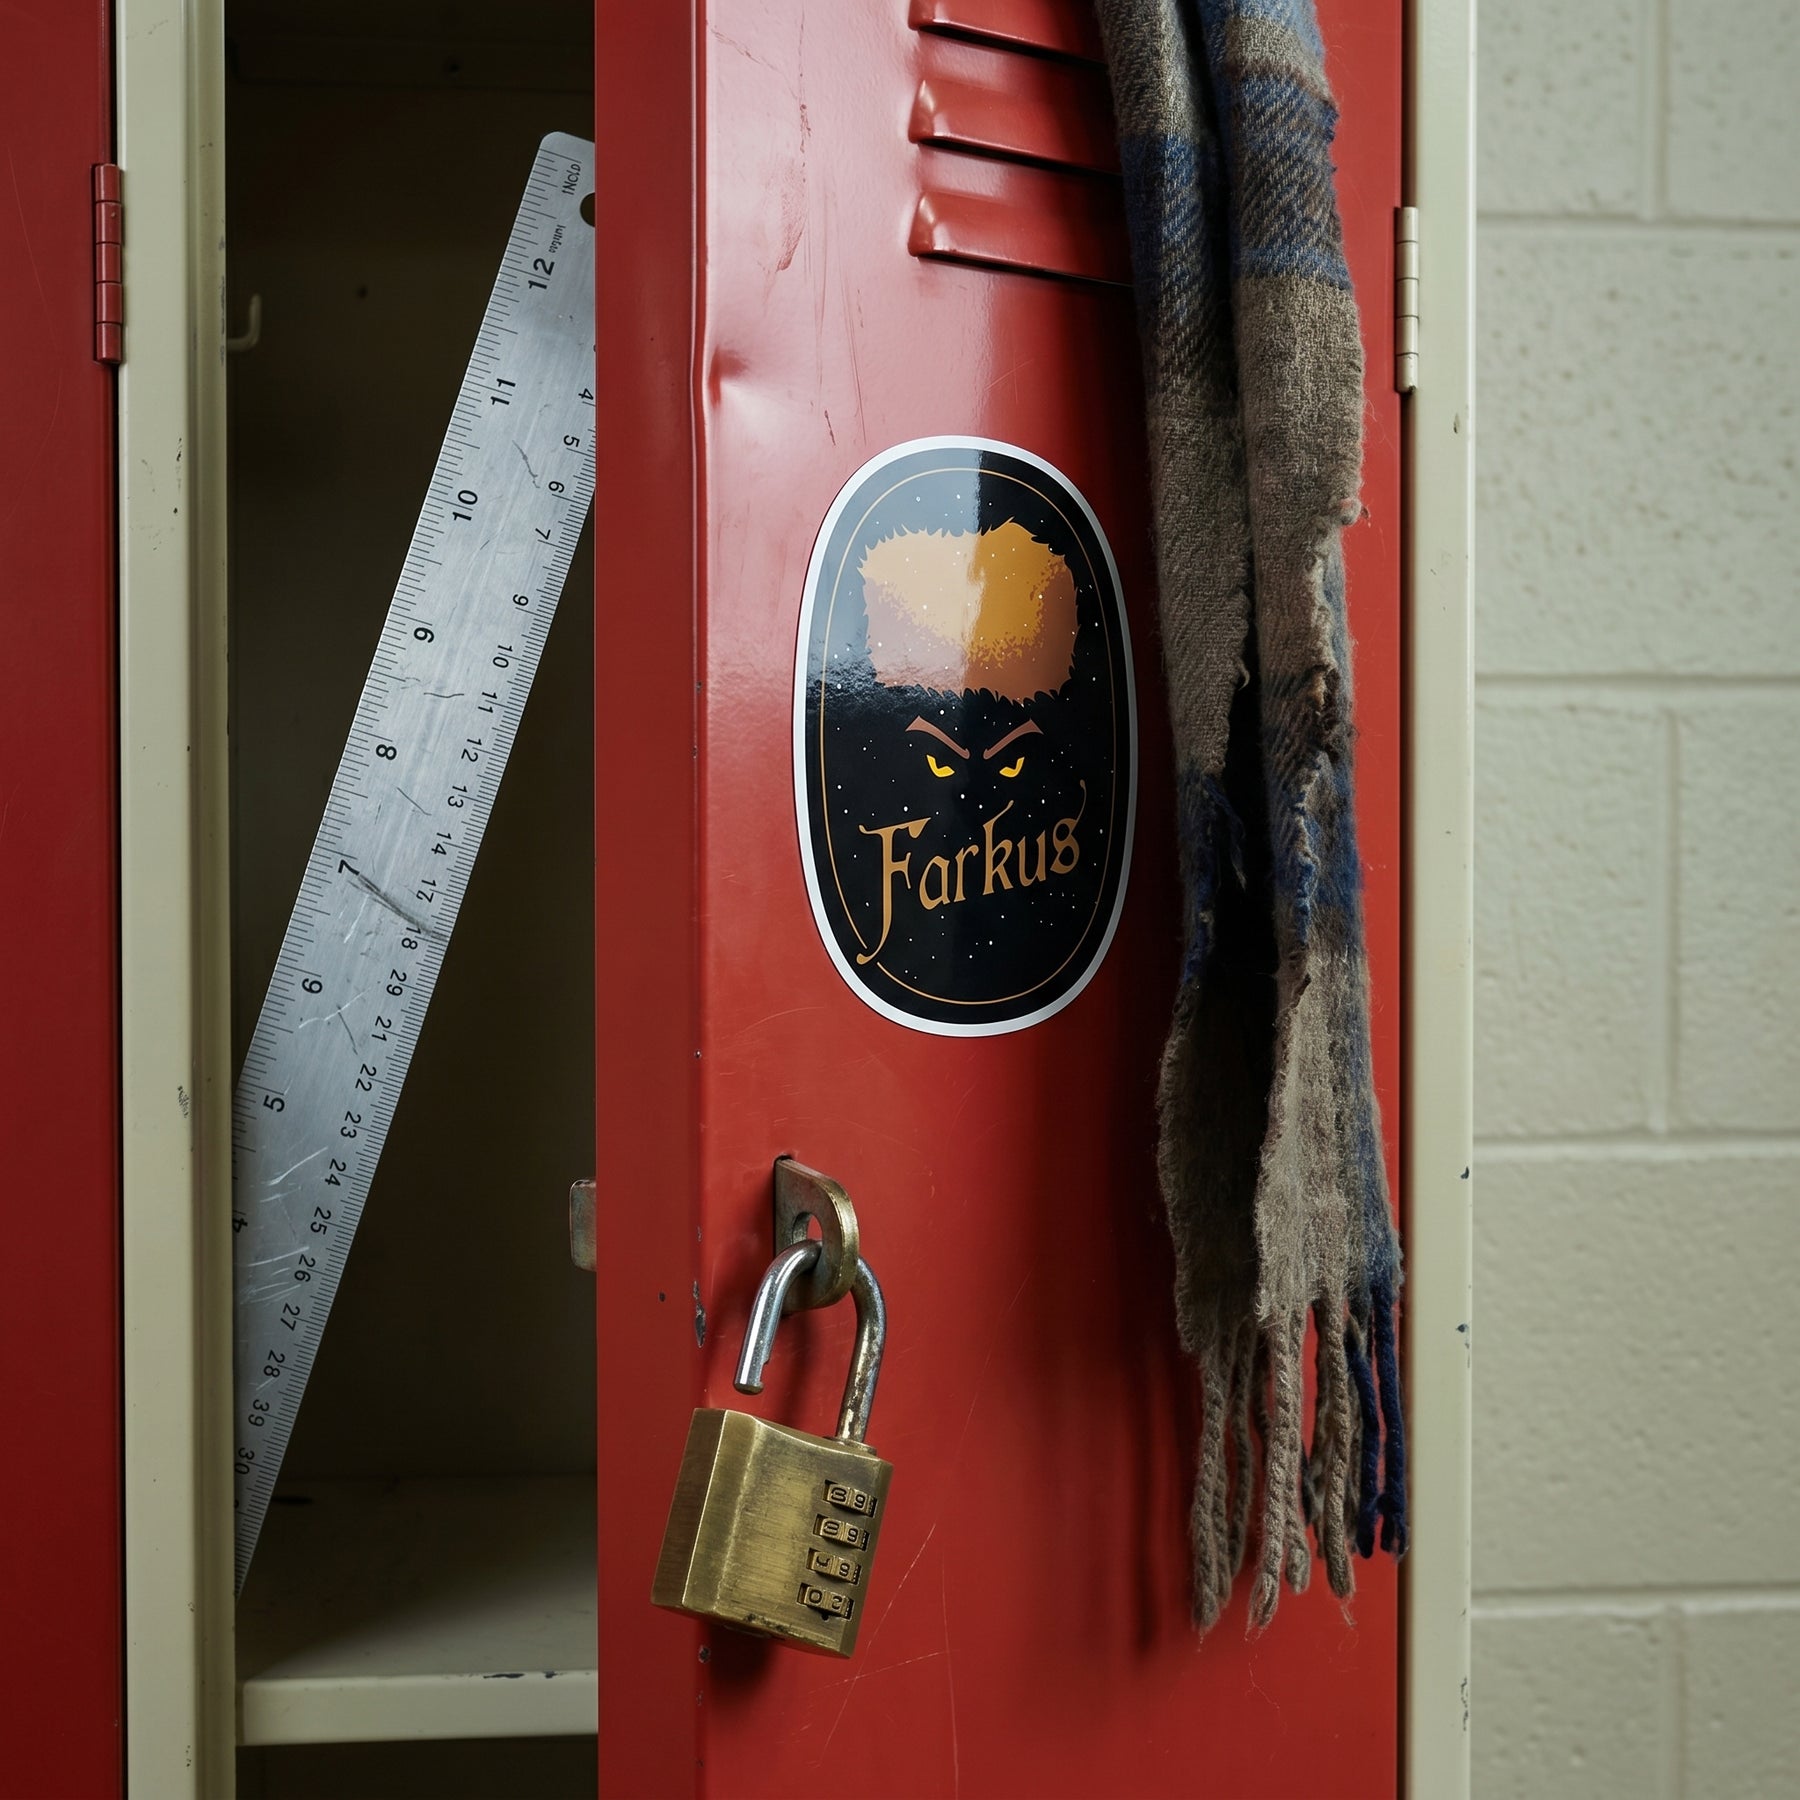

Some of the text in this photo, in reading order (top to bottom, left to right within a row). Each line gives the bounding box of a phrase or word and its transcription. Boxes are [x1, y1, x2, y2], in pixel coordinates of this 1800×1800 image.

[527, 257, 555, 290] 12
[490, 378, 516, 405] 11
[578, 388, 594, 400] 4
[563, 435, 580, 447] 5
[548, 480, 565, 493] 6
[452, 489, 478, 521] 10
[535, 528, 551, 540] 7
[512, 593, 529, 606] 9
[413, 627, 435, 643] 9
[492, 644, 513, 669] 10
[477, 691, 498, 714] 11
[375, 744, 397, 761] 8
[461, 738, 482, 762] 12
[447, 785, 468, 809] 13
[431, 832, 452, 856] 14
[338, 859, 360, 876] 7
[856, 779, 1087, 965] Farkus
[401, 926, 422, 950] 18
[301, 978, 323, 994] 6
[386, 969, 407, 996] 29
[371, 1016, 392, 1043] 21
[355, 1063, 377, 1092] 22
[263, 1095, 285, 1113] 5
[340, 1111, 362, 1139] 23
[325, 1158, 347, 1187] 24
[310, 1207, 332, 1235] 25
[294, 1254, 316, 1283] 26
[280, 1302, 301, 1331] 27
[263, 1350, 286, 1378] 28
[248, 1399, 270, 1427] 39
[234, 1447, 255, 1476] 30
